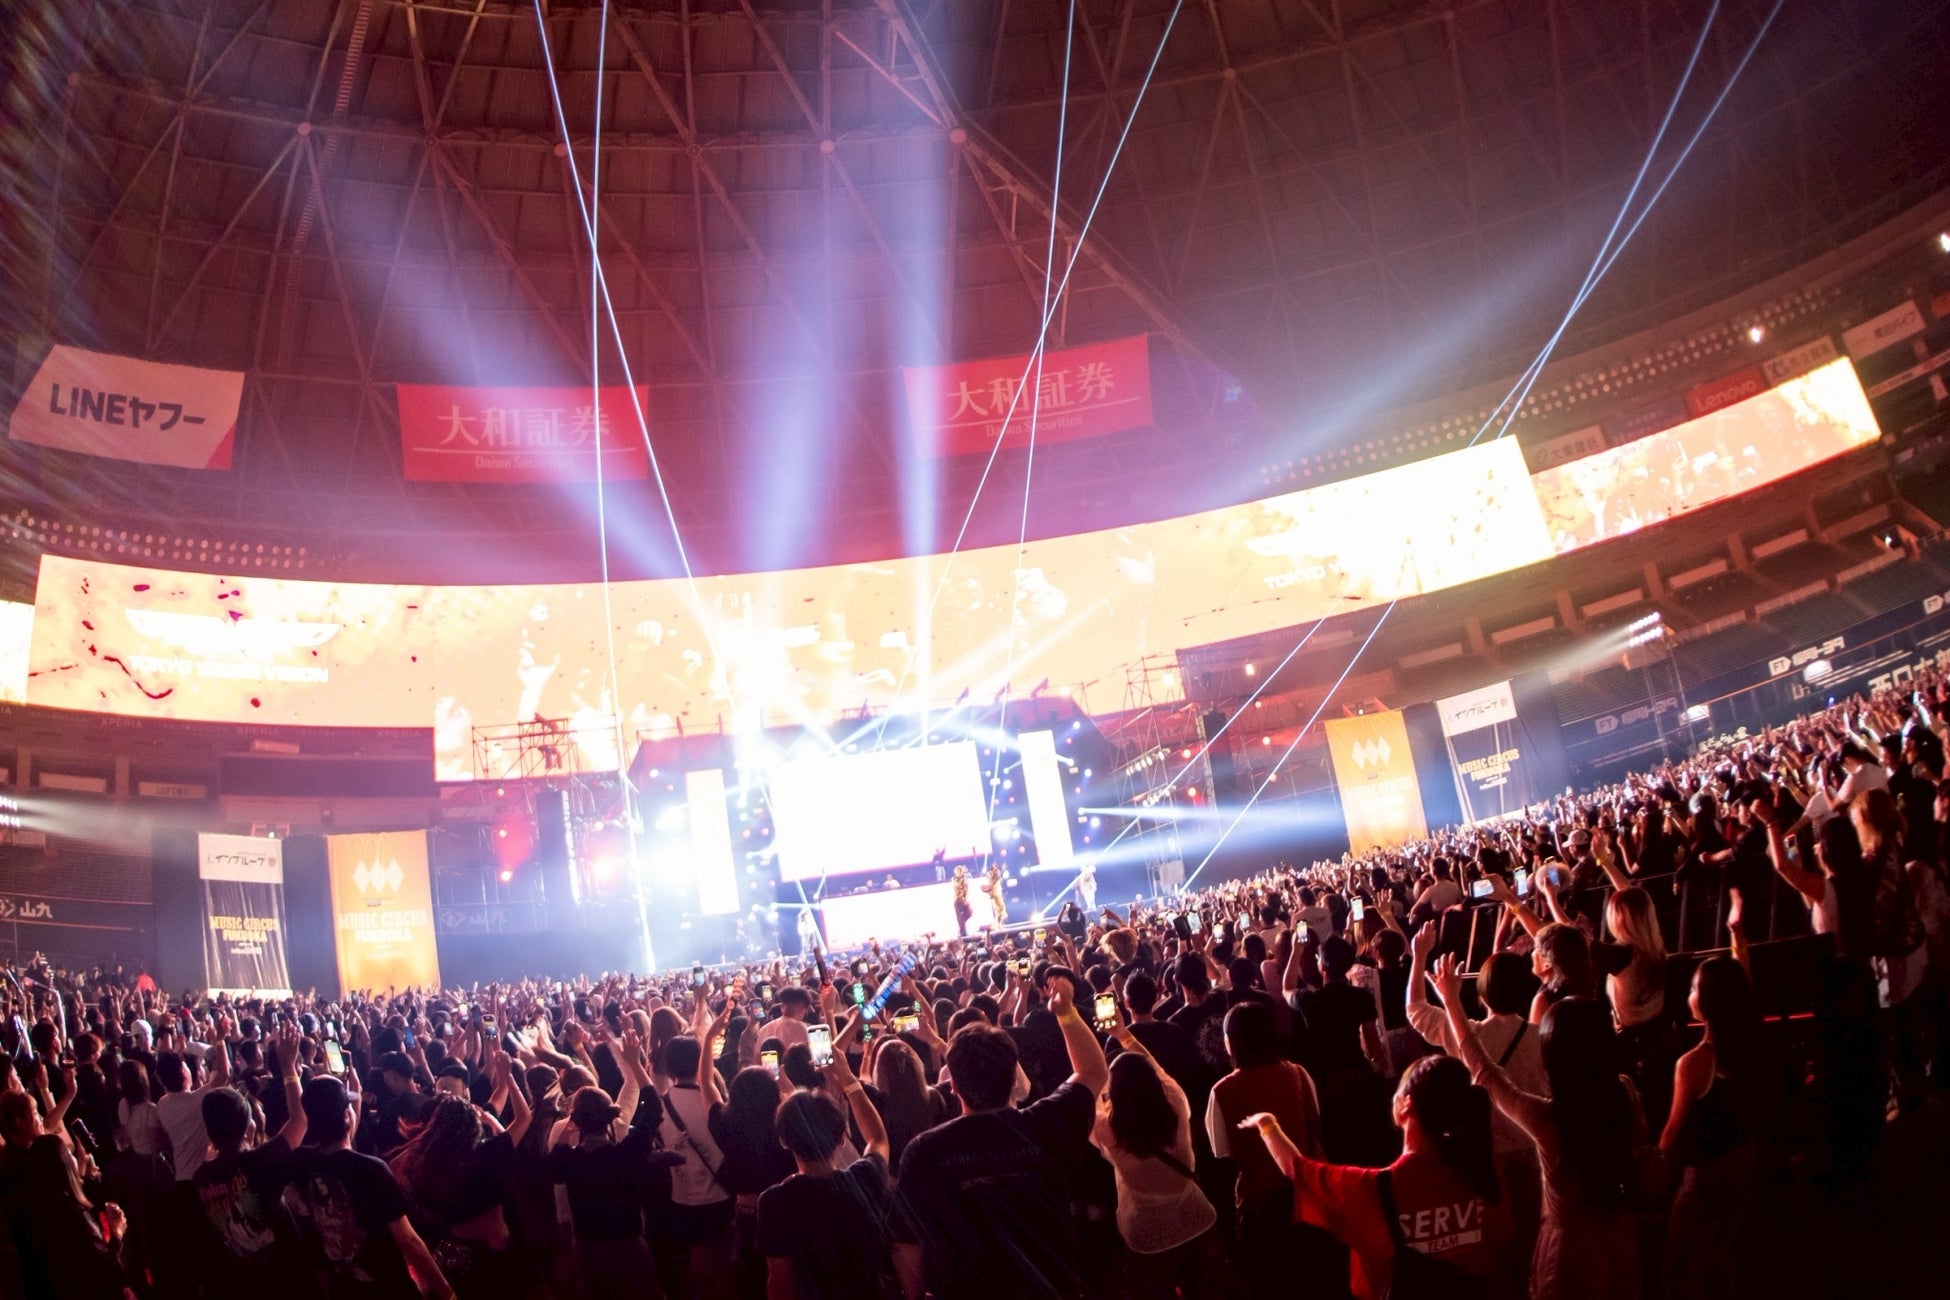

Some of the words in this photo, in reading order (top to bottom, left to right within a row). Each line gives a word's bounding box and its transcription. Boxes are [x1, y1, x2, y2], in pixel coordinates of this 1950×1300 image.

[945, 362, 1115, 421] 大和証券
[1696, 379, 1757, 411] Lenovo
[50, 383, 206, 432] LINEヤフー
[437, 405, 611, 447] 大和証券
[986, 422, 1022, 437] Daiwa
[1024, 415, 1084, 433] Securities
[475, 455, 513, 469] Daiwa
[129, 656, 191, 675] TOKYO
[100, 718, 143, 729] XPERIA
[1458, 757, 1488, 775] MUSIC
[20, 901, 53, 919] 山九
[338, 911, 379, 929] MUSIC
[380, 909, 428, 928] CIRCUS
[209, 916, 242, 930] MUSIC
[243, 917, 278, 931] CIRCUS
[1429, 1236, 1459, 1252] TEAM
